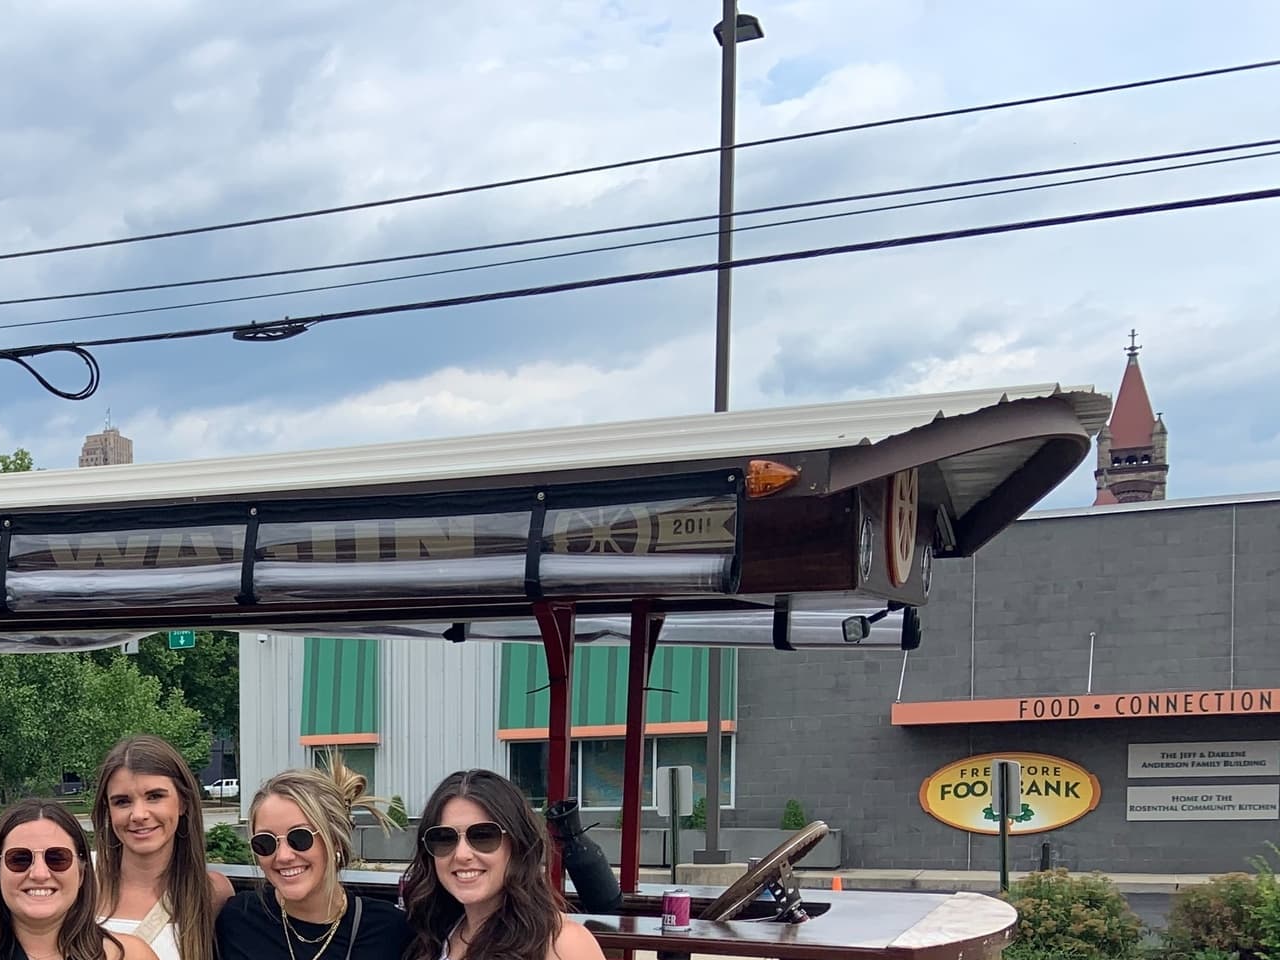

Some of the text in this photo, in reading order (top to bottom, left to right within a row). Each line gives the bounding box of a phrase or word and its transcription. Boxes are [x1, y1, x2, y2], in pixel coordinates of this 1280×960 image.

[1019, 691, 1272, 719] FOOD CONNECTION
[1160, 751, 1177, 760] THE
[1180, 751, 1196, 760] JEFF
[1207, 750, 1246, 758] DARLENE
[1141, 759, 1266, 769] ANDERSON FAMILY BUILDING
[960, 766, 1061, 779] FRETORE
[940, 780, 1081, 801] FOOANK
[1171, 795, 1199, 803] HOME
[1215, 794, 1233, 802] THE
[1181, 804, 1236, 812] COMMUNITY
[1238, 803, 1277, 811] KITCHEN
